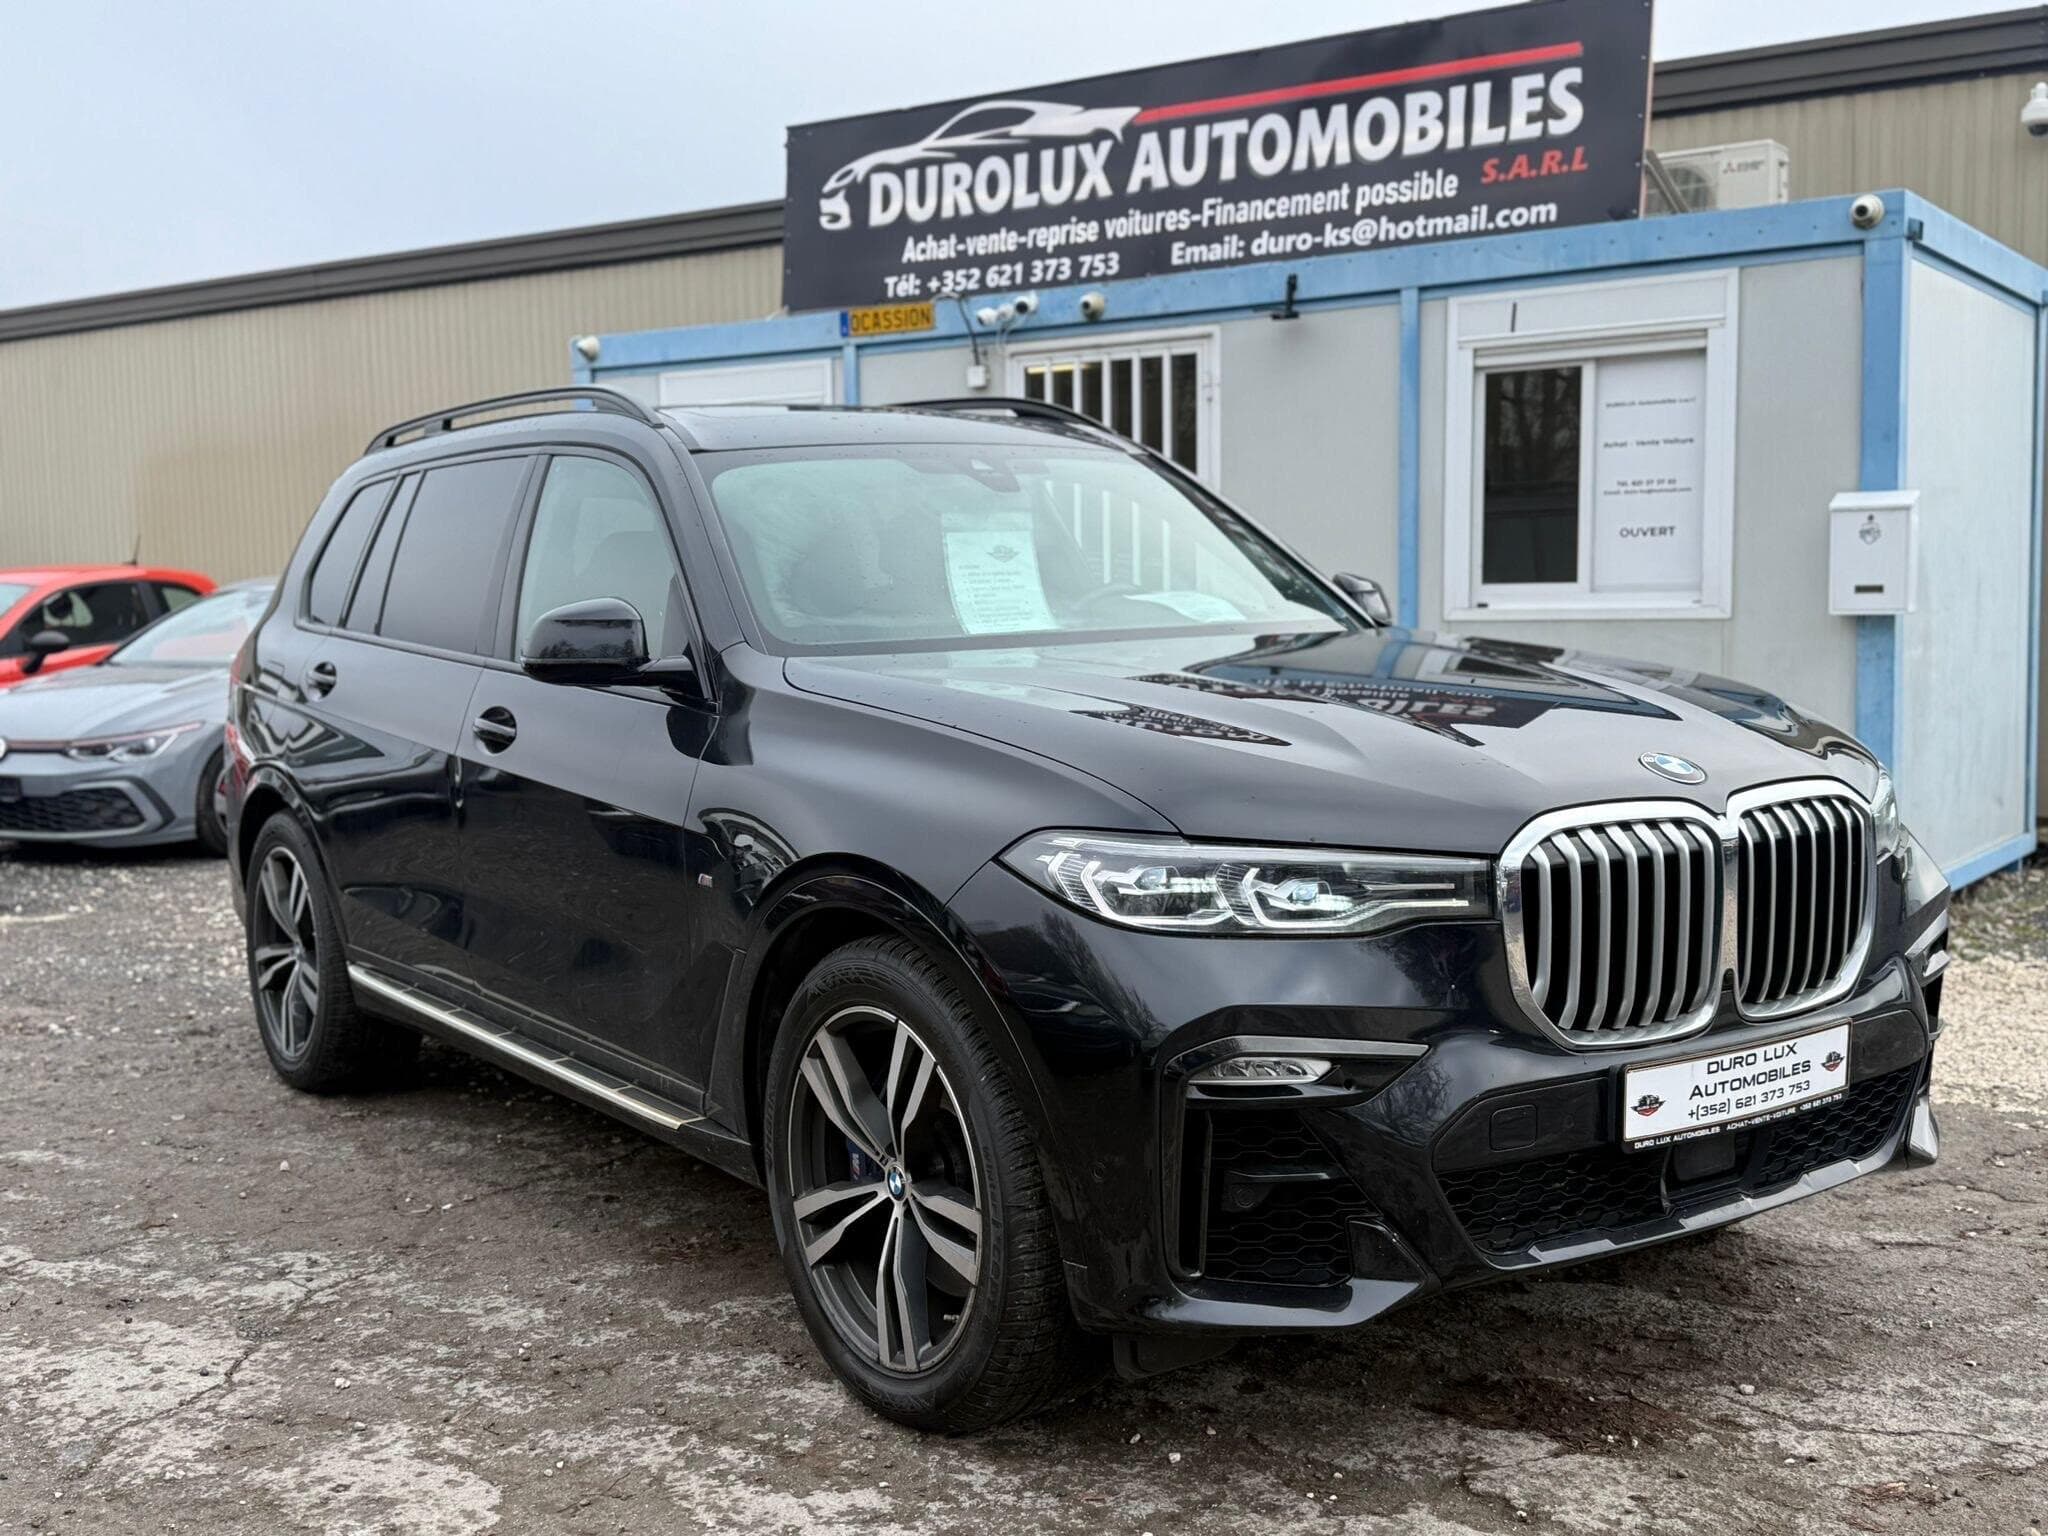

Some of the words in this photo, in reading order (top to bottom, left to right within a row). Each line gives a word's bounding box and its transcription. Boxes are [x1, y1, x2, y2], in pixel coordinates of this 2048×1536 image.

[869, 139, 1113, 228] DUROLUX
[1126, 67, 1584, 196] AUTOMOBILES
[1480, 146, 1588, 185] S.A.R.L
[902, 217, 1099, 264] Achat-vente-reprise
[1104, 183, 1350, 240] voitures-Financement
[1355, 169, 1459, 211] possible
[1170, 236, 1245, 267] Email:
[1250, 202, 1557, 258] duro-ks@hotmail.com
[884, 274, 921, 299] Tél:
[927, 267, 980, 294] +352
[985, 262, 1024, 290] 621
[1030, 257, 1071, 284] 373
[1079, 252, 1120, 277] 753
[851, 307, 931, 332] OCASSION
[1619, 526, 1677, 538] OUVERT
[1707, 1053, 1757, 1075] DURO
[1763, 1042, 1798, 1063] LUX
[1689, 1060, 1811, 1100] AUTOMOBILES
[1688, 1098, 1731, 1121] +(352)
[1735, 1094, 1757, 1109] 621
[1760, 1087, 1785, 1103] 373
[1788, 1080, 1810, 1096] 753
[1634, 1139, 1655, 1150] DURO
[1656, 1136, 1672, 1145] LUX
[1672, 1126, 1721, 1142] AUTOMOBILES
